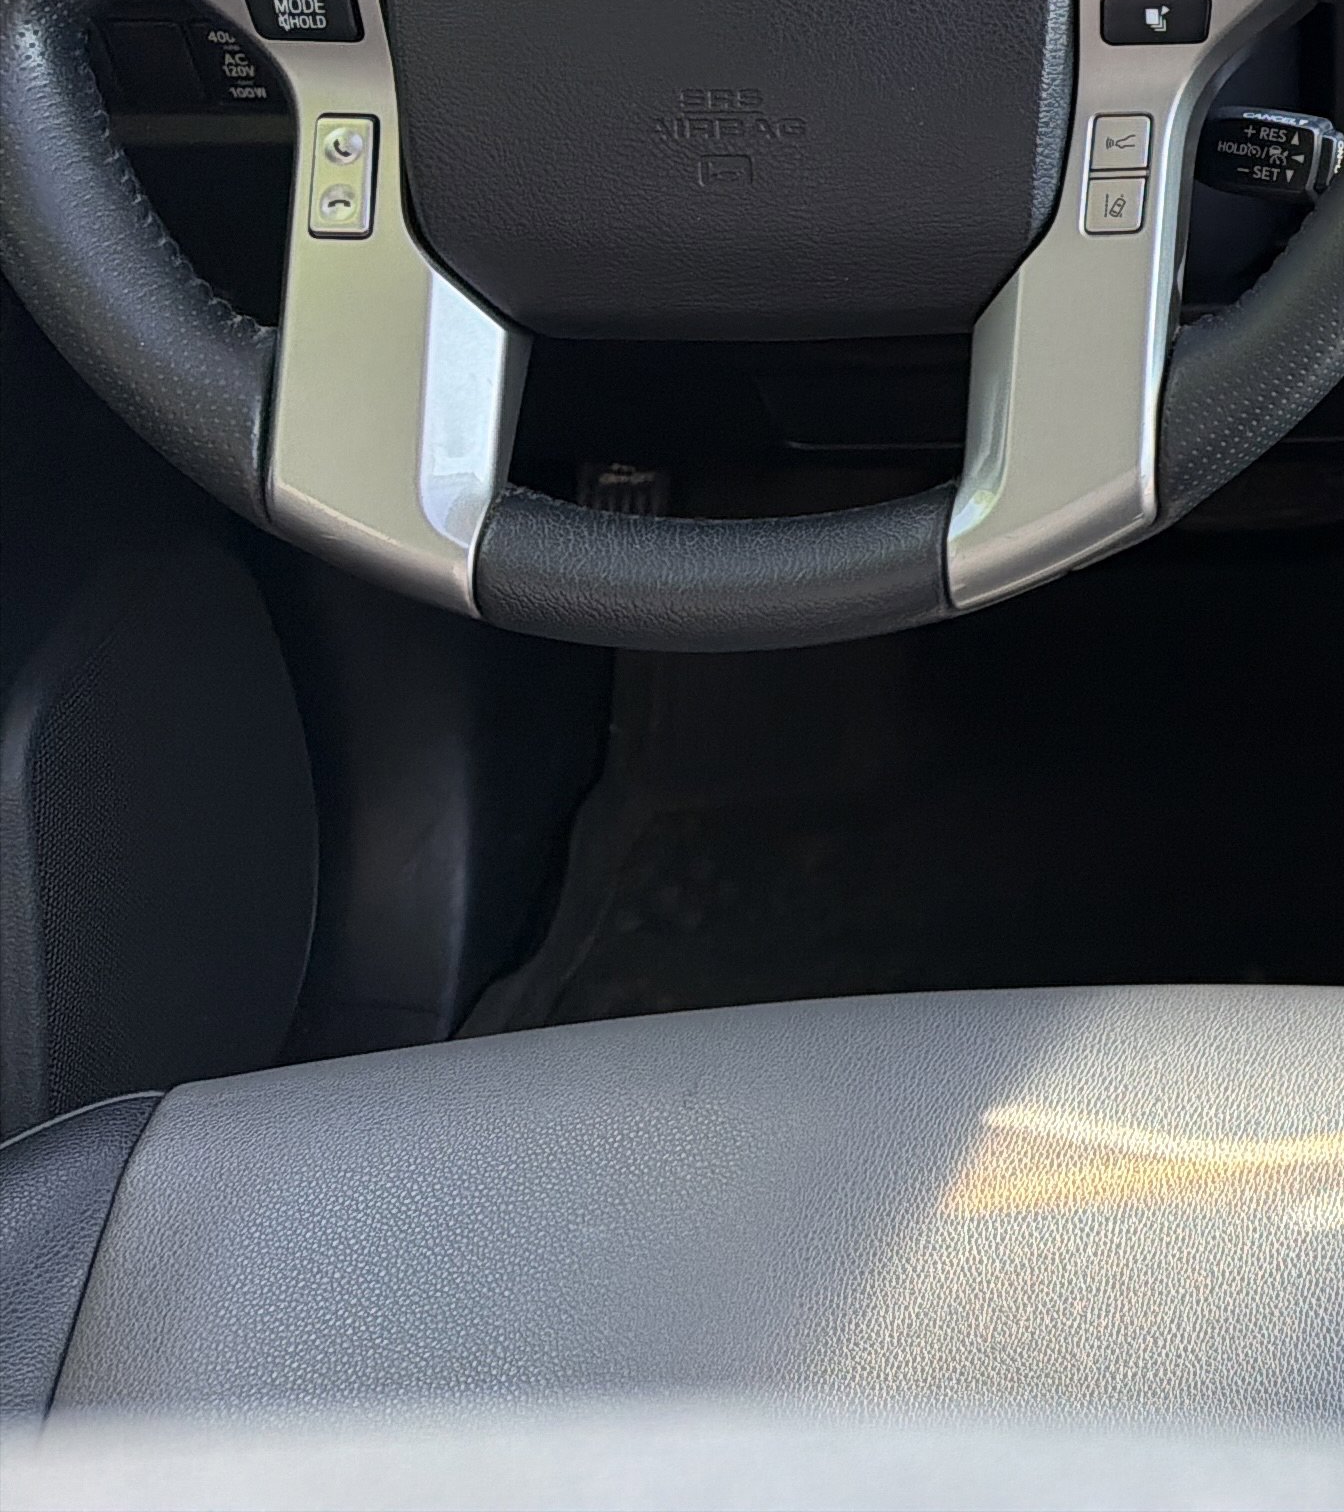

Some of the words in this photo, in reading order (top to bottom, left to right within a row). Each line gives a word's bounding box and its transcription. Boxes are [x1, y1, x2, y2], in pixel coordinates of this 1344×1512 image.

[289, 14, 327, 29] HOLD
[224, 53, 249, 66] AC
[222, 65, 256, 77] 120V
[679, 88, 763, 109] SRS
[1243, 112, 1299, 125] CANCEL
[653, 118, 807, 139] AIRBAG
[1259, 126, 1288, 143] RES
[1217, 140, 1250, 159] HOLD
[1253, 166, 1281, 182] SET
